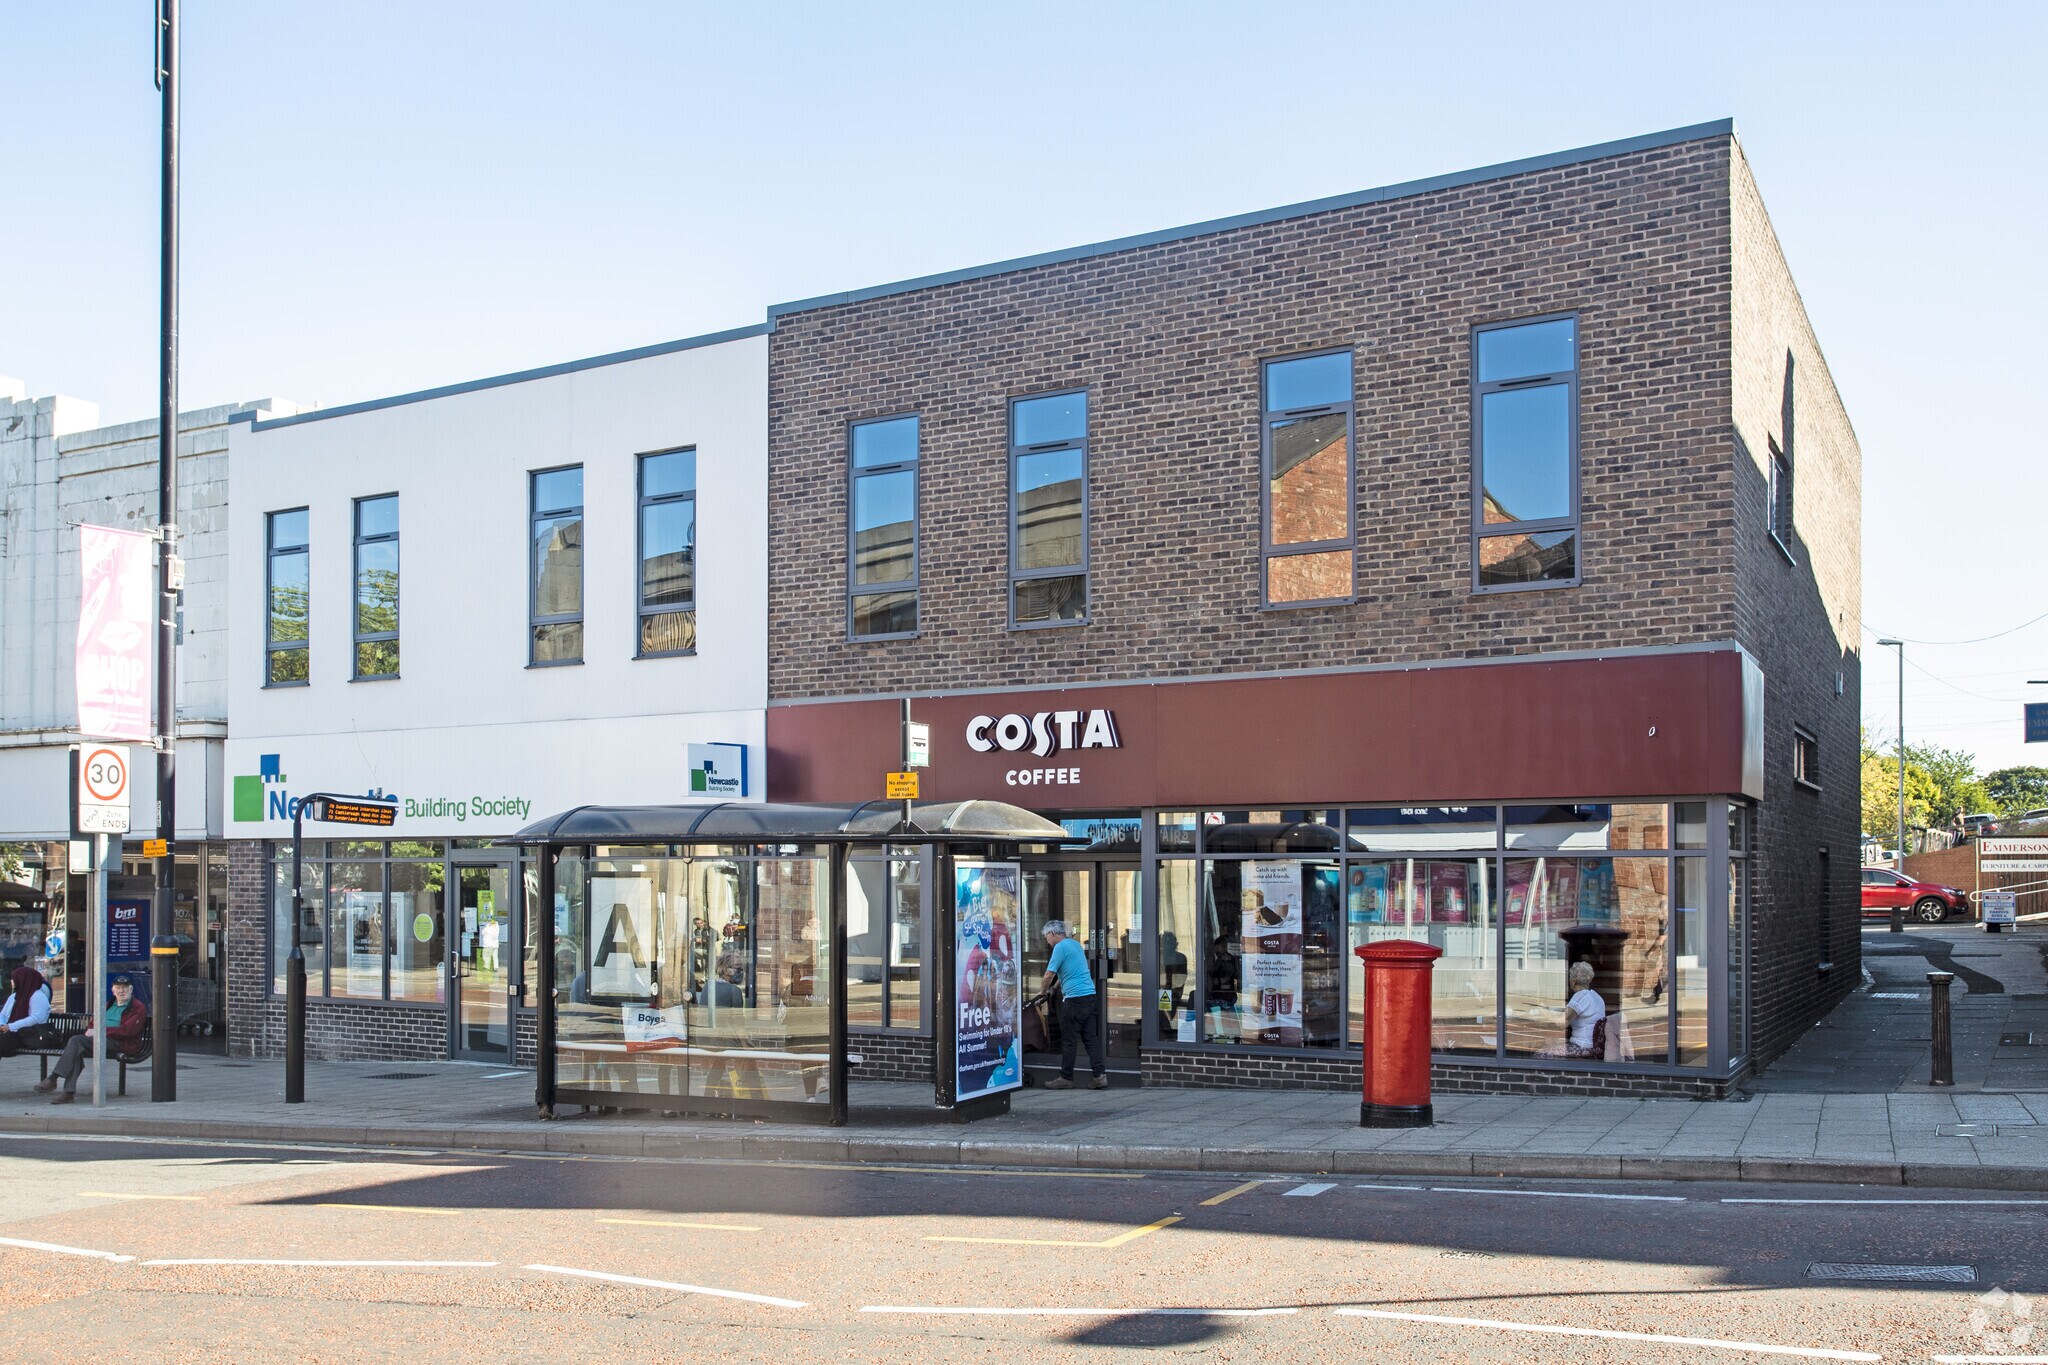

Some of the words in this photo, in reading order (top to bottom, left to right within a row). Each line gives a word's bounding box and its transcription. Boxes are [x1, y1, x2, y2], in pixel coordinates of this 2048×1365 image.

[966, 709, 1120, 757] COSTA
[91, 763, 120, 784] 30
[708, 777, 739, 786] Newcastle
[1005, 767, 1081, 786] COFFEE
[405, 798, 467, 822] Building
[471, 796, 531, 820] Society
[102, 820, 127, 829] ENDS
[593, 903, 647, 969] A
[637, 1013, 666, 1026] Boyes
[960, 1002, 991, 1029] Free
[959, 1030, 983, 1042] Swimming
[990, 1026, 1003, 1036] Under
[967, 1040, 987, 1053] Summer!
